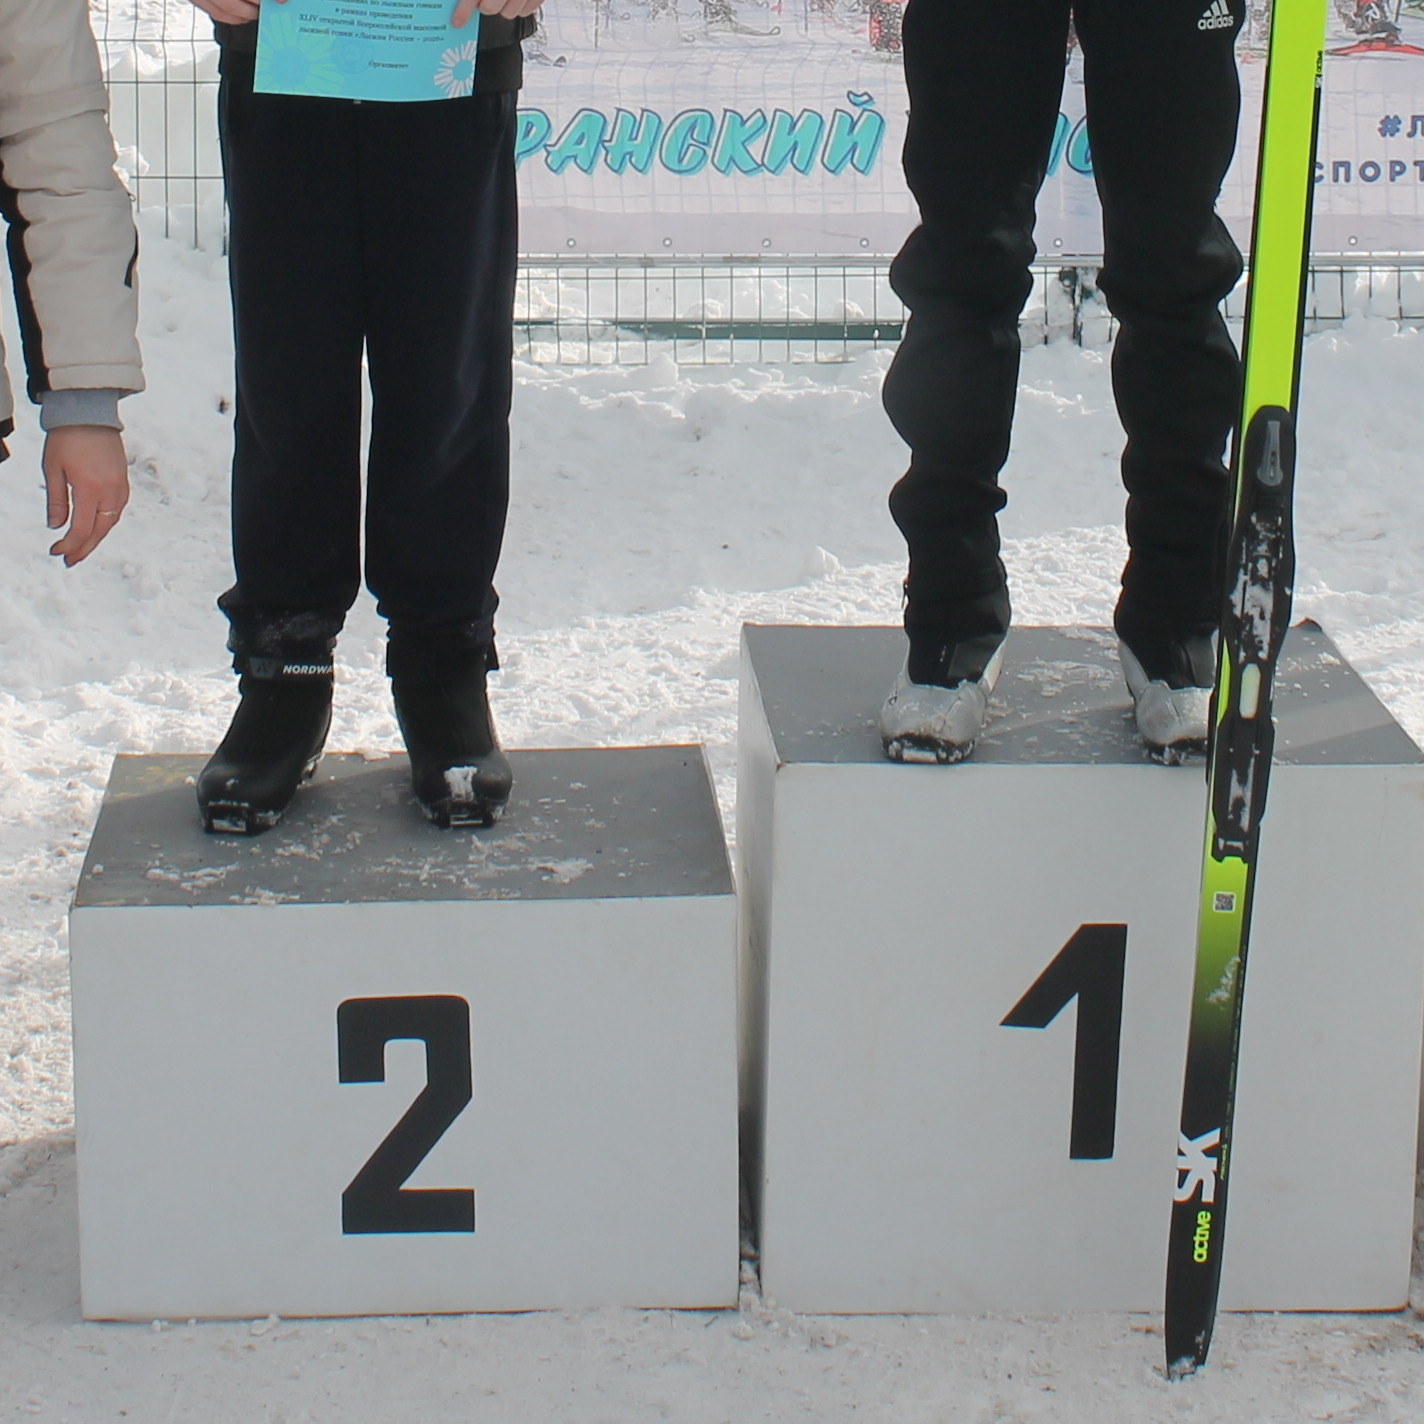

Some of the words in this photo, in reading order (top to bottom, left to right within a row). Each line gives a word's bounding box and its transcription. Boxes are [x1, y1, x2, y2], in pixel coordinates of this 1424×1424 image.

[1197, 15, 1234, 30] adidas
[516, 90, 887, 176] РАНСКИЙ
[282, 664, 333, 675] NORDWA
[1000, 924, 1127, 1159] 1
[337, 996, 475, 1234] 2
[1173, 1127, 1221, 1204] SK
[1193, 1209, 1212, 1263] active
